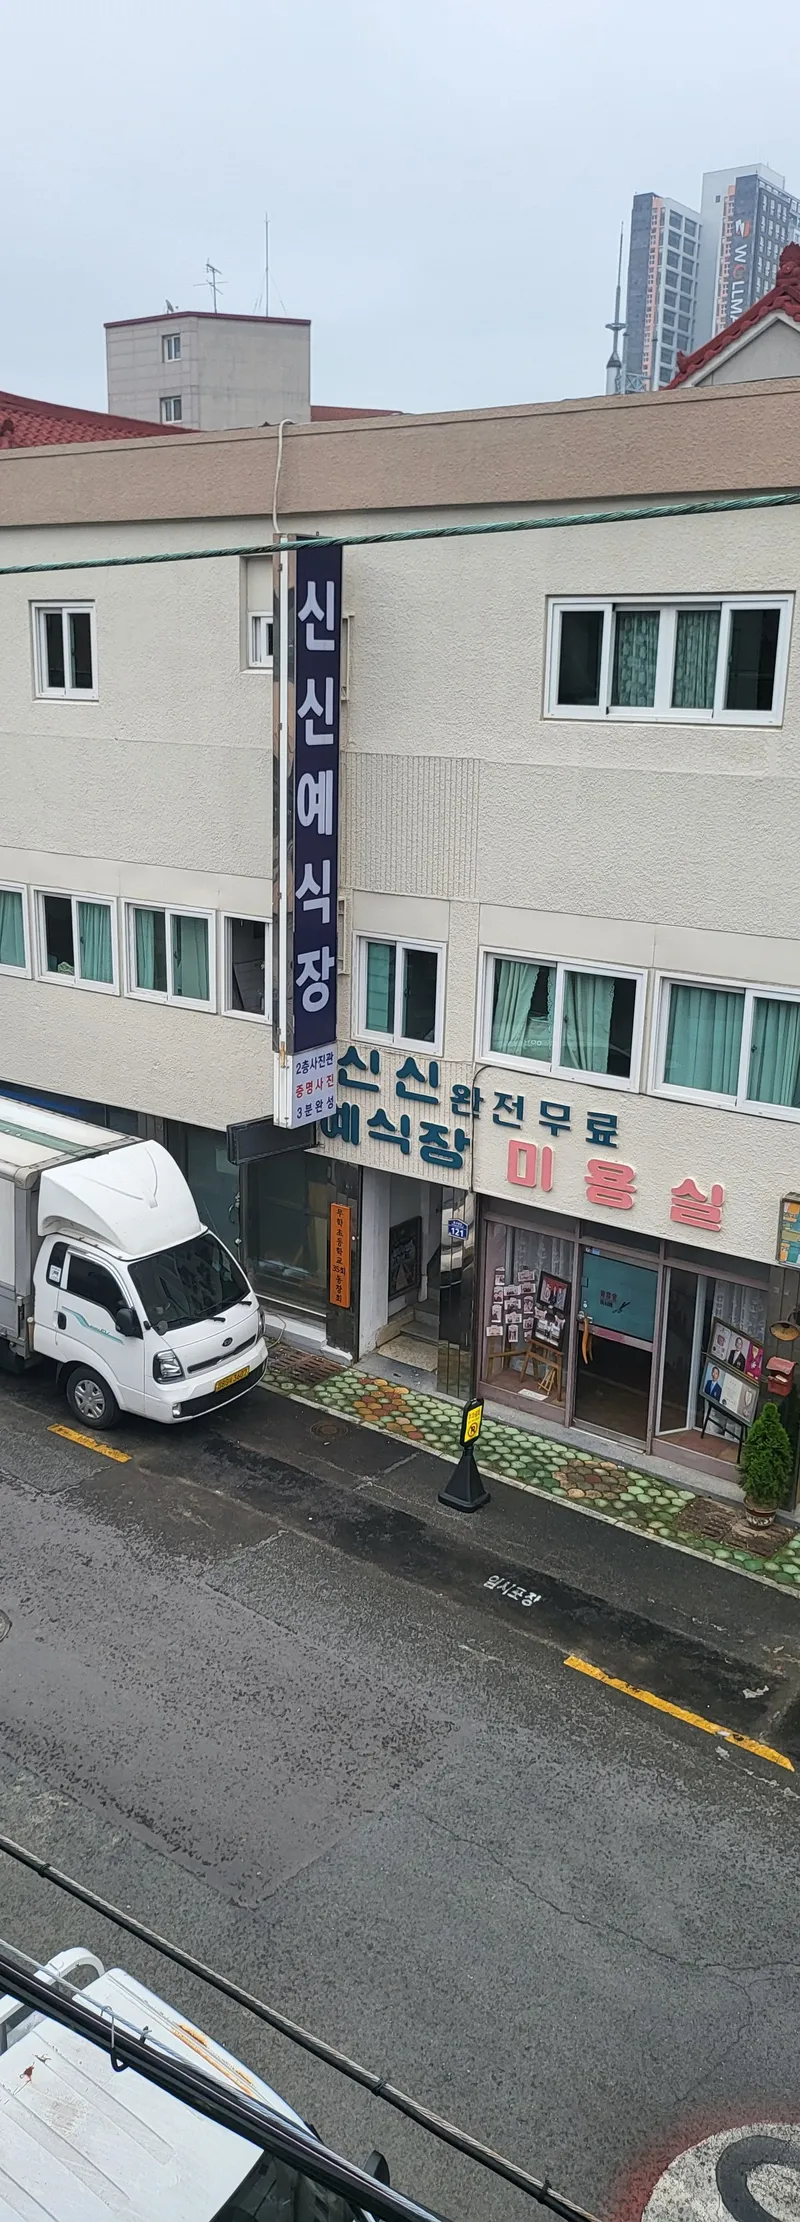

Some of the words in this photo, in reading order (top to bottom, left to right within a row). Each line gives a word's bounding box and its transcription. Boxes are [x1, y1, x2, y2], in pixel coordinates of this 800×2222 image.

[295, 580, 336, 1013] 신신예식장
[295, 1051, 334, 1075] 2층사진관
[295, 1074, 334, 1099] 증명사진
[337, 1045, 440, 1105] 신신
[320, 1102, 471, 1170] 예식장
[450, 1083, 620, 1148] 완전무료
[507, 1139, 724, 1232] 미용실
[450, 1227, 465, 1238] 121
[483, 1575, 542, 1607] 임시포장
